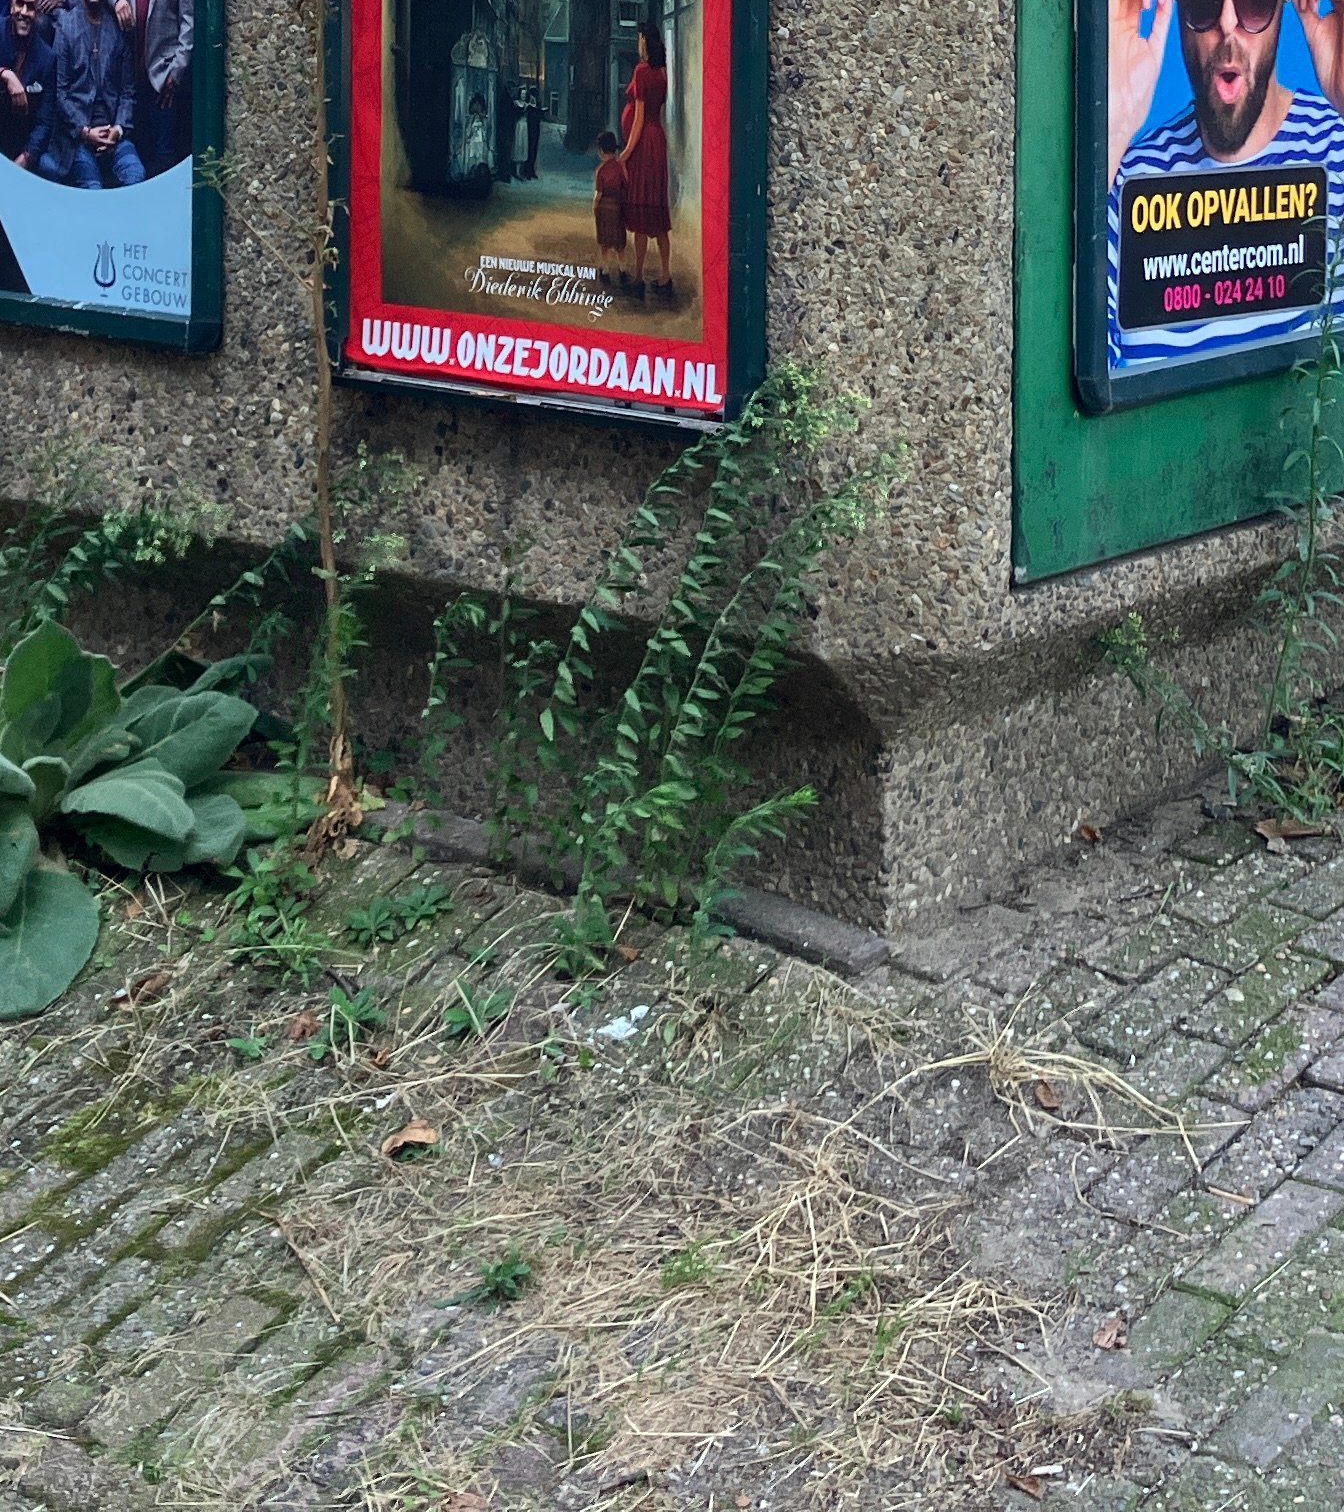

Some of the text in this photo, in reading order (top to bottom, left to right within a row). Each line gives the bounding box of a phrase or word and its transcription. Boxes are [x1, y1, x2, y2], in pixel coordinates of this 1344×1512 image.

[1131, 182, 1318, 233] OOK OPVALLEN?
[123, 243, 148, 260] HET
[480, 255, 597, 280] EEN NIEUWE MUSICAL VAN
[1143, 234, 1304, 281] www.centercom.nl
[122, 264, 188, 287] CONCERT
[464, 266, 614, 323] Diederik Ebbinge
[1163, 284, 1201, 312] 0800
[1214, 279, 1242, 306] 024
[1245, 276, 1264, 301] 24
[1266, 274, 1286, 299] 10
[121, 285, 187, 308] GEBOUW
[361, 319, 723, 405] WWW.ONZEJORDAAN.NL
